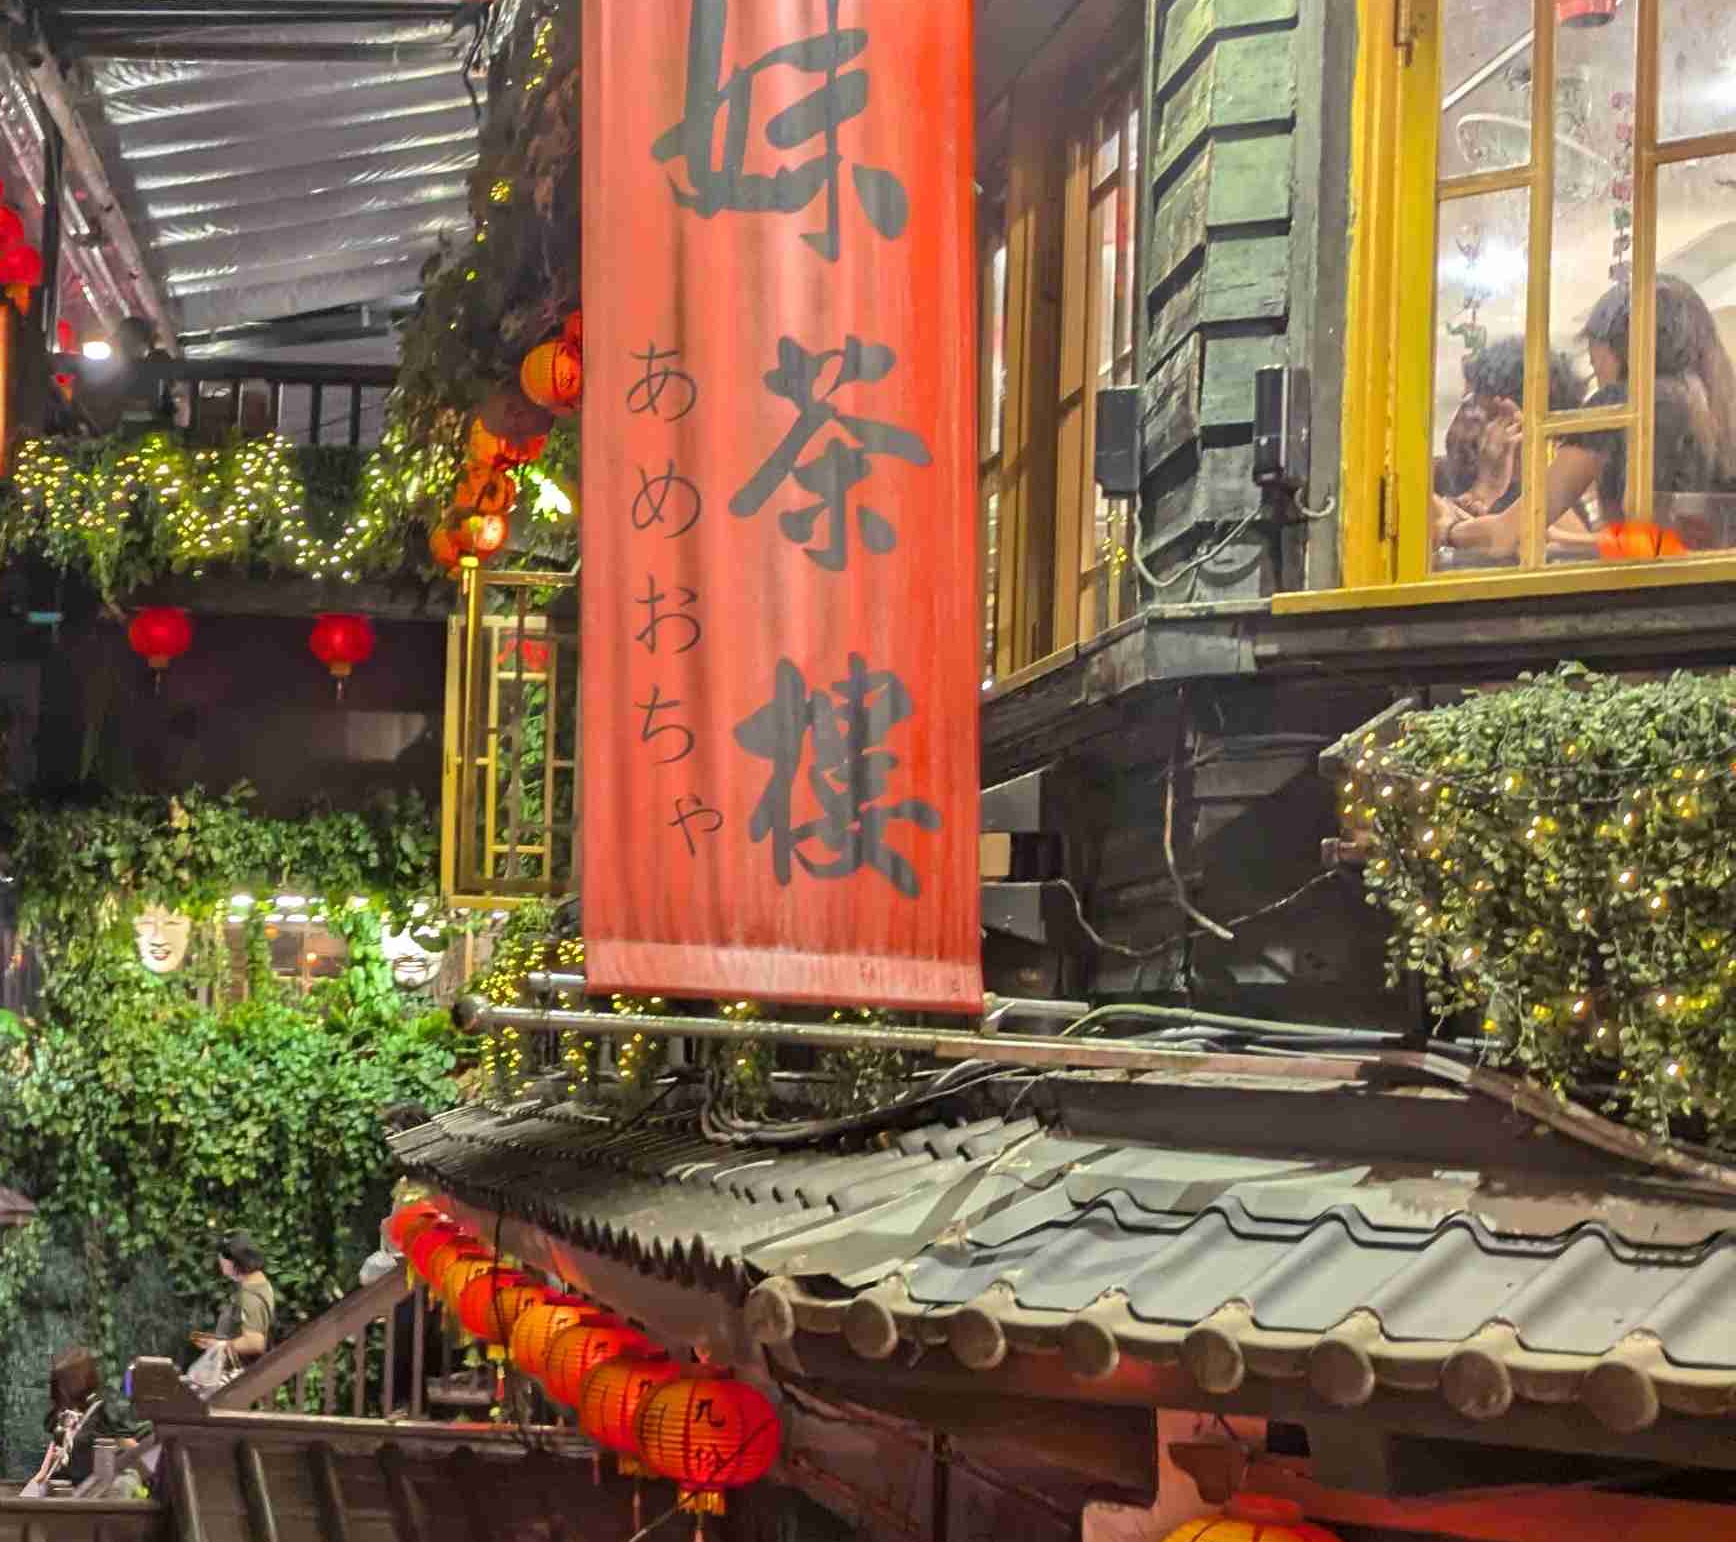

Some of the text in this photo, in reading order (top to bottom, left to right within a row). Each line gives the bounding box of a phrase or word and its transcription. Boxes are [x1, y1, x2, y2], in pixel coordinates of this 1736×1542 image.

[625, 338, 724, 857] あめおちゃ
